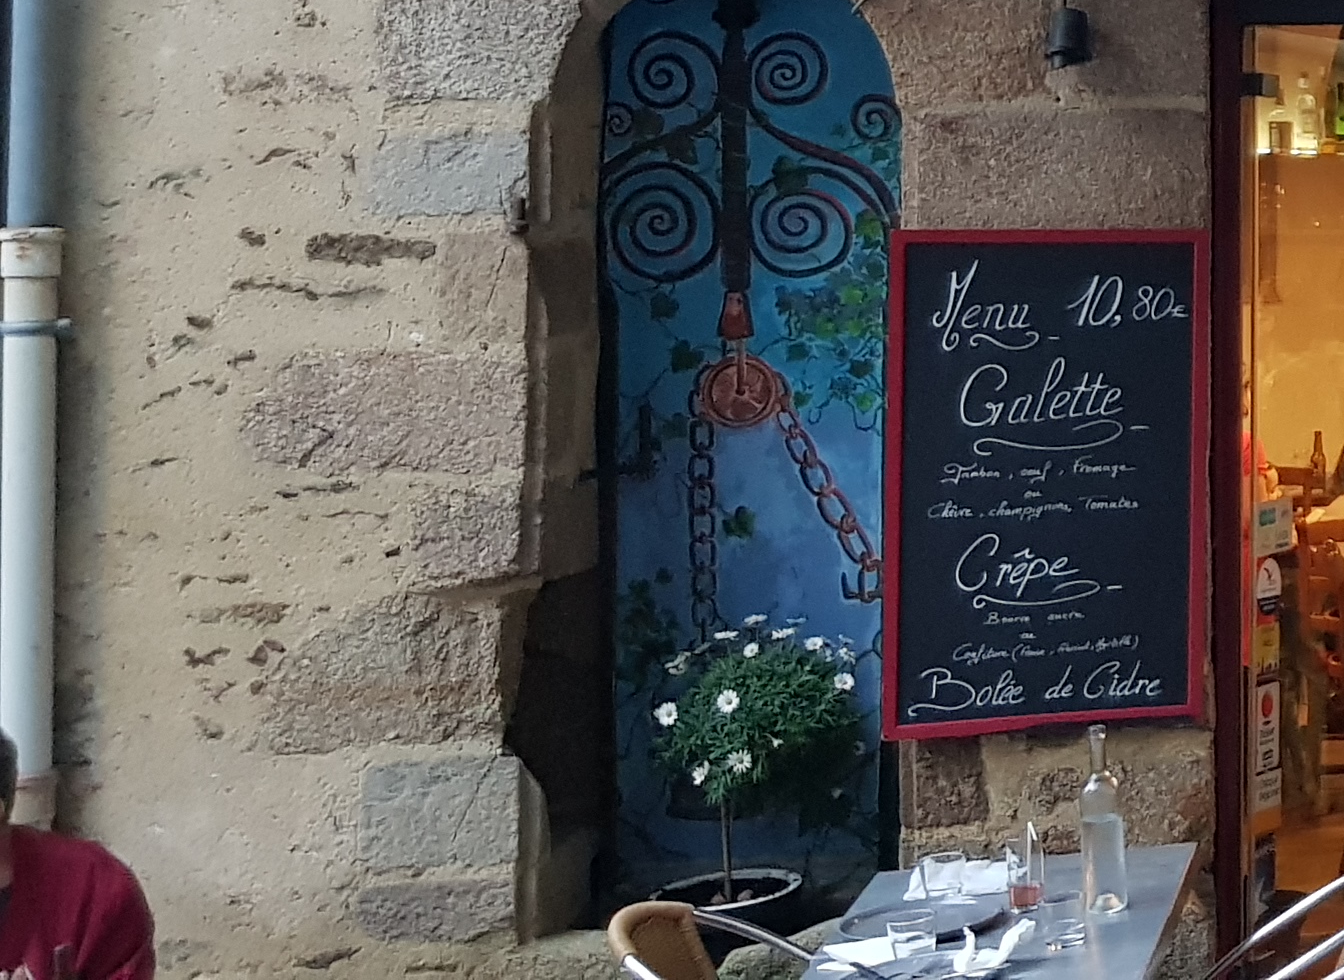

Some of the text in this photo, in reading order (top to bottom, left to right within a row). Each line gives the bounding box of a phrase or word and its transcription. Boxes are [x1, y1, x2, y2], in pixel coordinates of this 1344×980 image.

[932, 259, 1188, 351] Menu 10,80€
[960, 357, 1124, 427] Galette
[1023, 489, 1043, 499] ou
[956, 534, 1080, 597] Crêpe
[908, 660, 1162, 716] Bolée de Cidre
